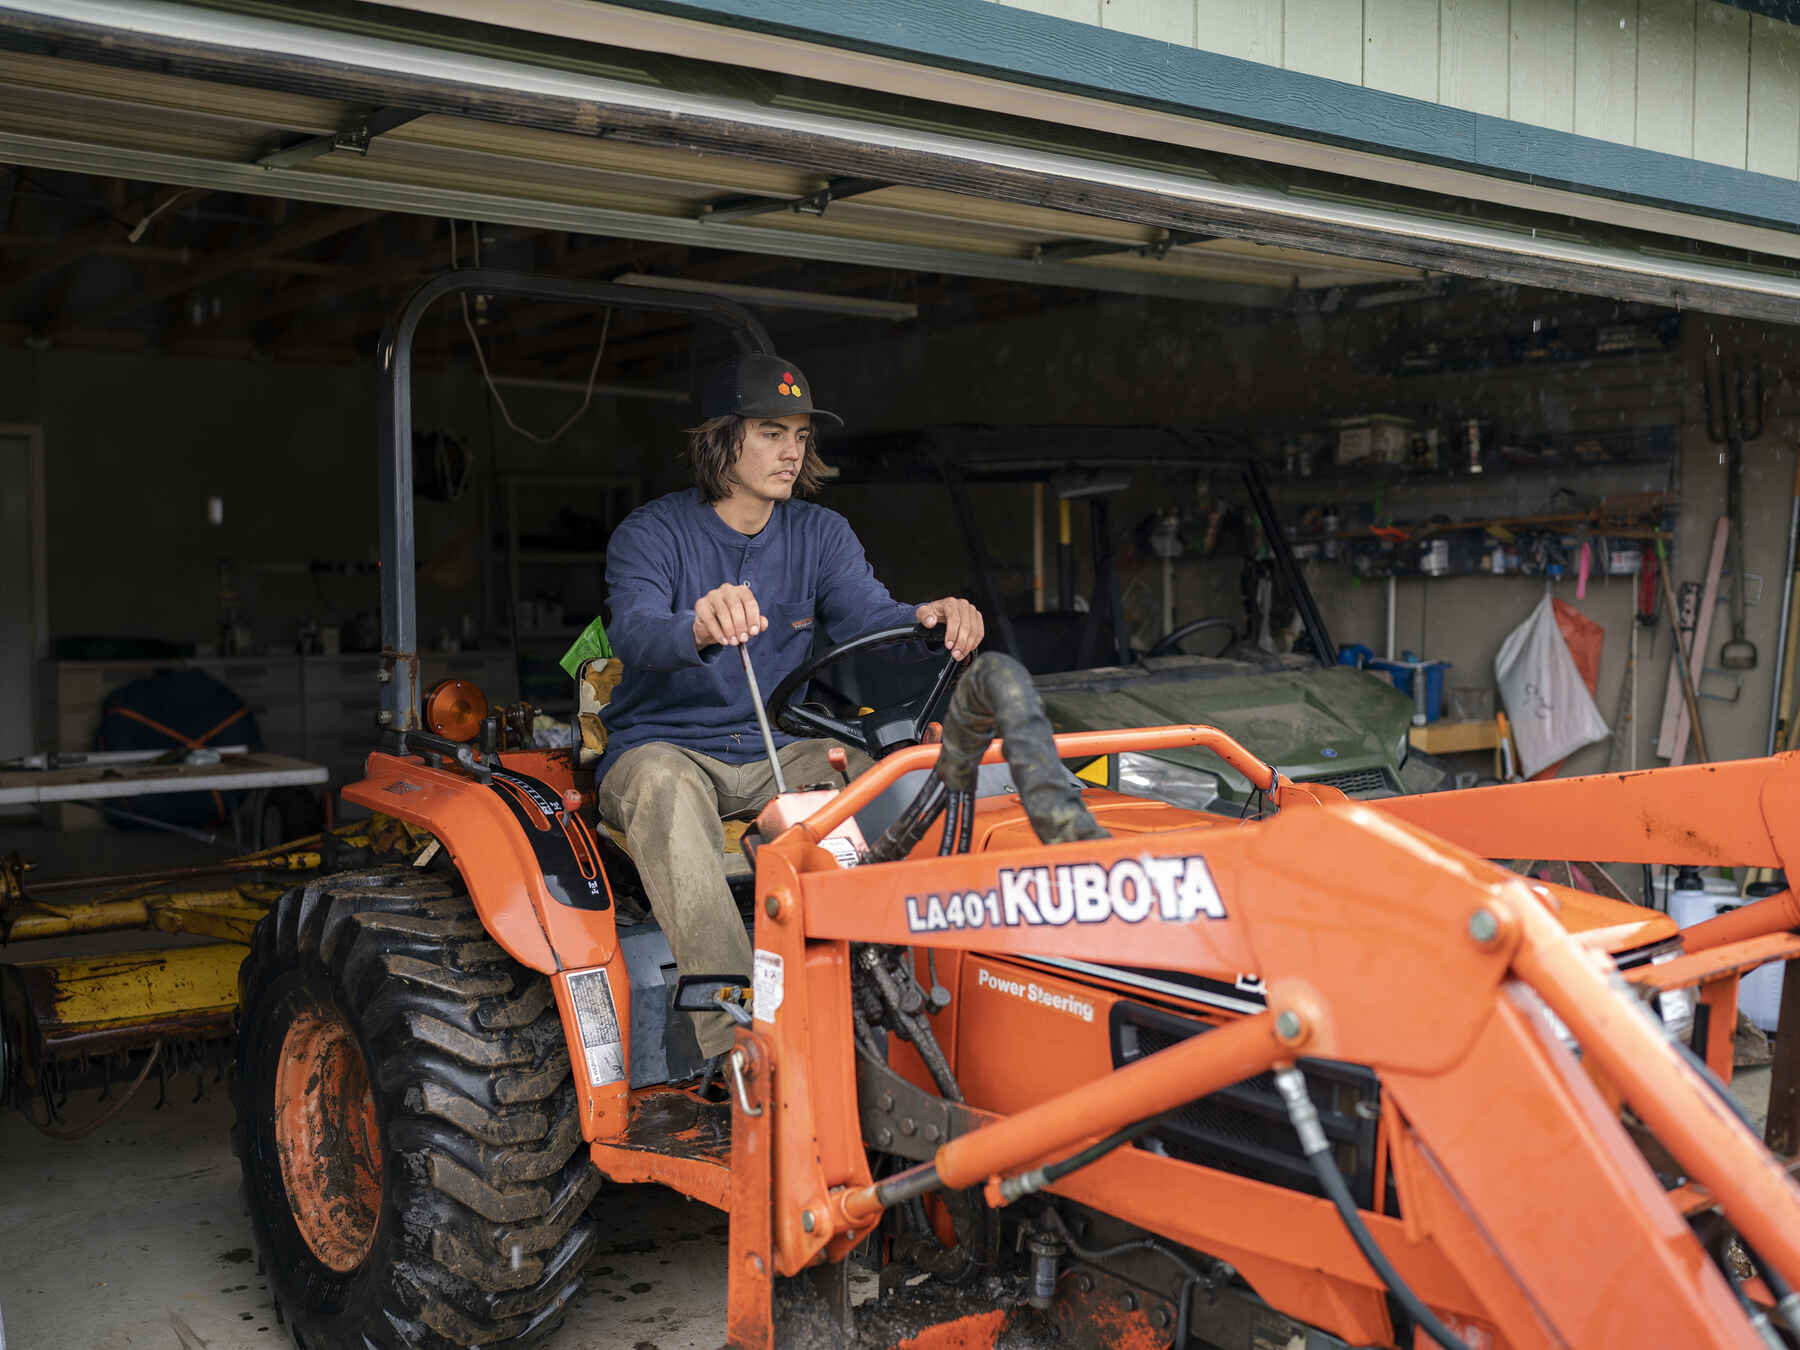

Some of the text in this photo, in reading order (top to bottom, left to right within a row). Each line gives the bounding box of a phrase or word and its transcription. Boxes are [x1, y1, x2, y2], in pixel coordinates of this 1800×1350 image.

[906, 855, 1228, 933] LA401 KUBOTA
[978, 967, 1094, 1022] Power Steering
